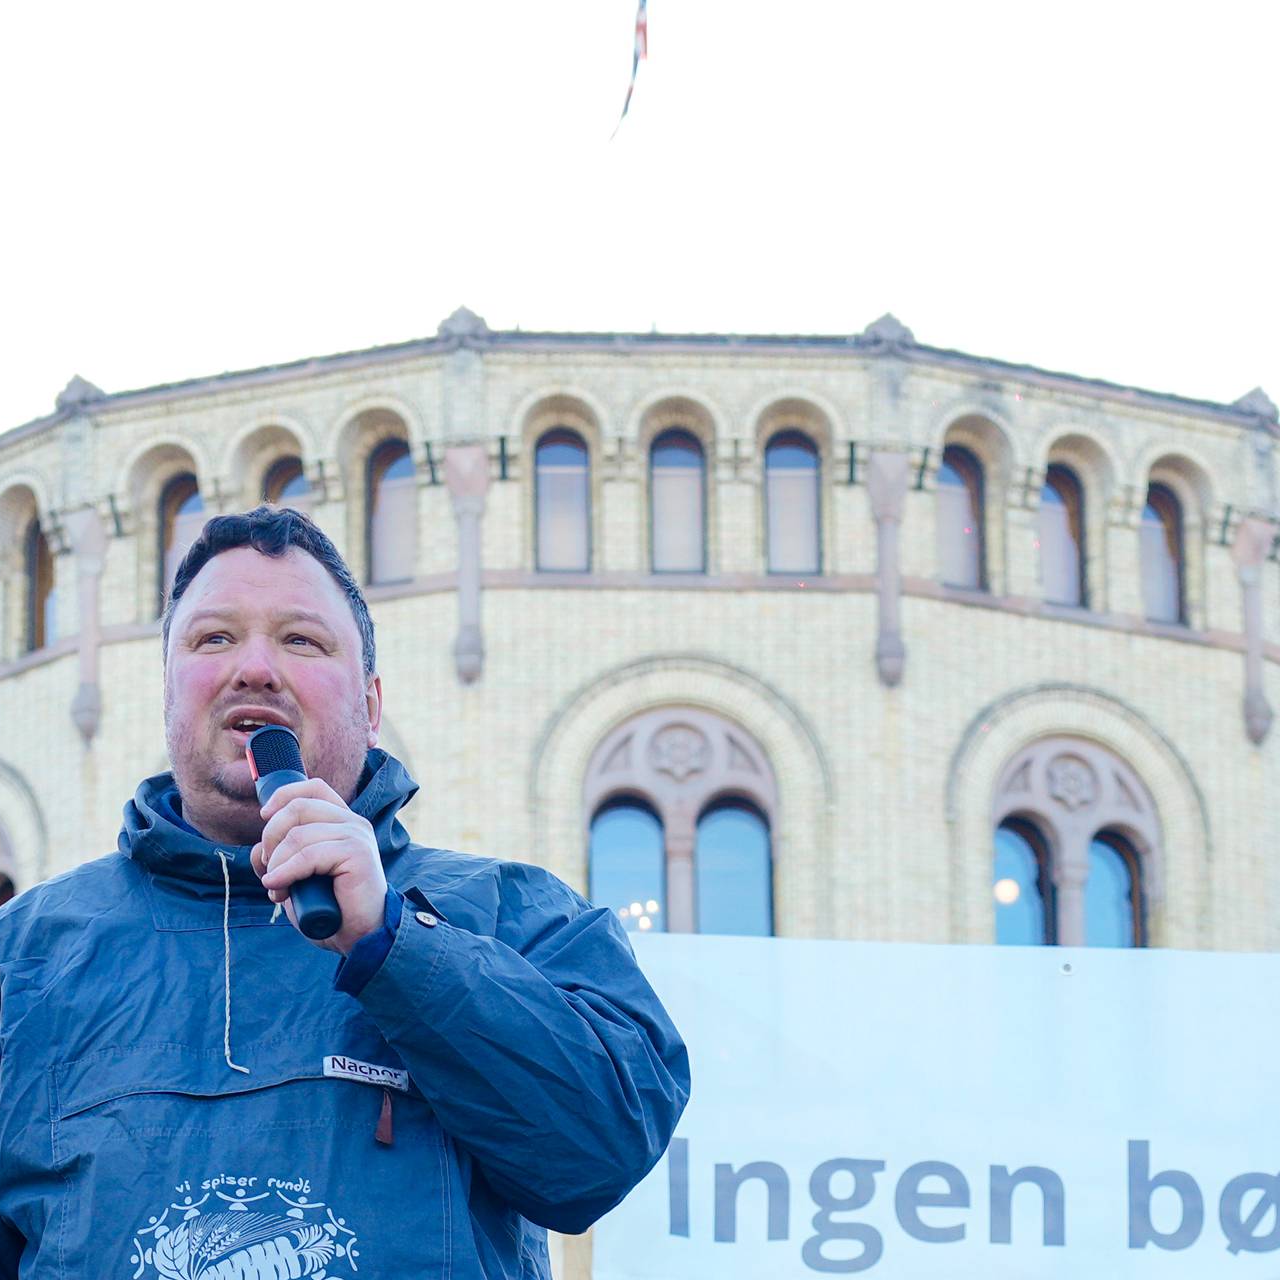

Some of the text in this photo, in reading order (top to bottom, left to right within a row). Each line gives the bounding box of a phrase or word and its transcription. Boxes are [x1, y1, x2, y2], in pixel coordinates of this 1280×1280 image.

[175, 1173, 312, 1194] vi spiser rundt
[668, 1137, 1067, 1275] Ingen
